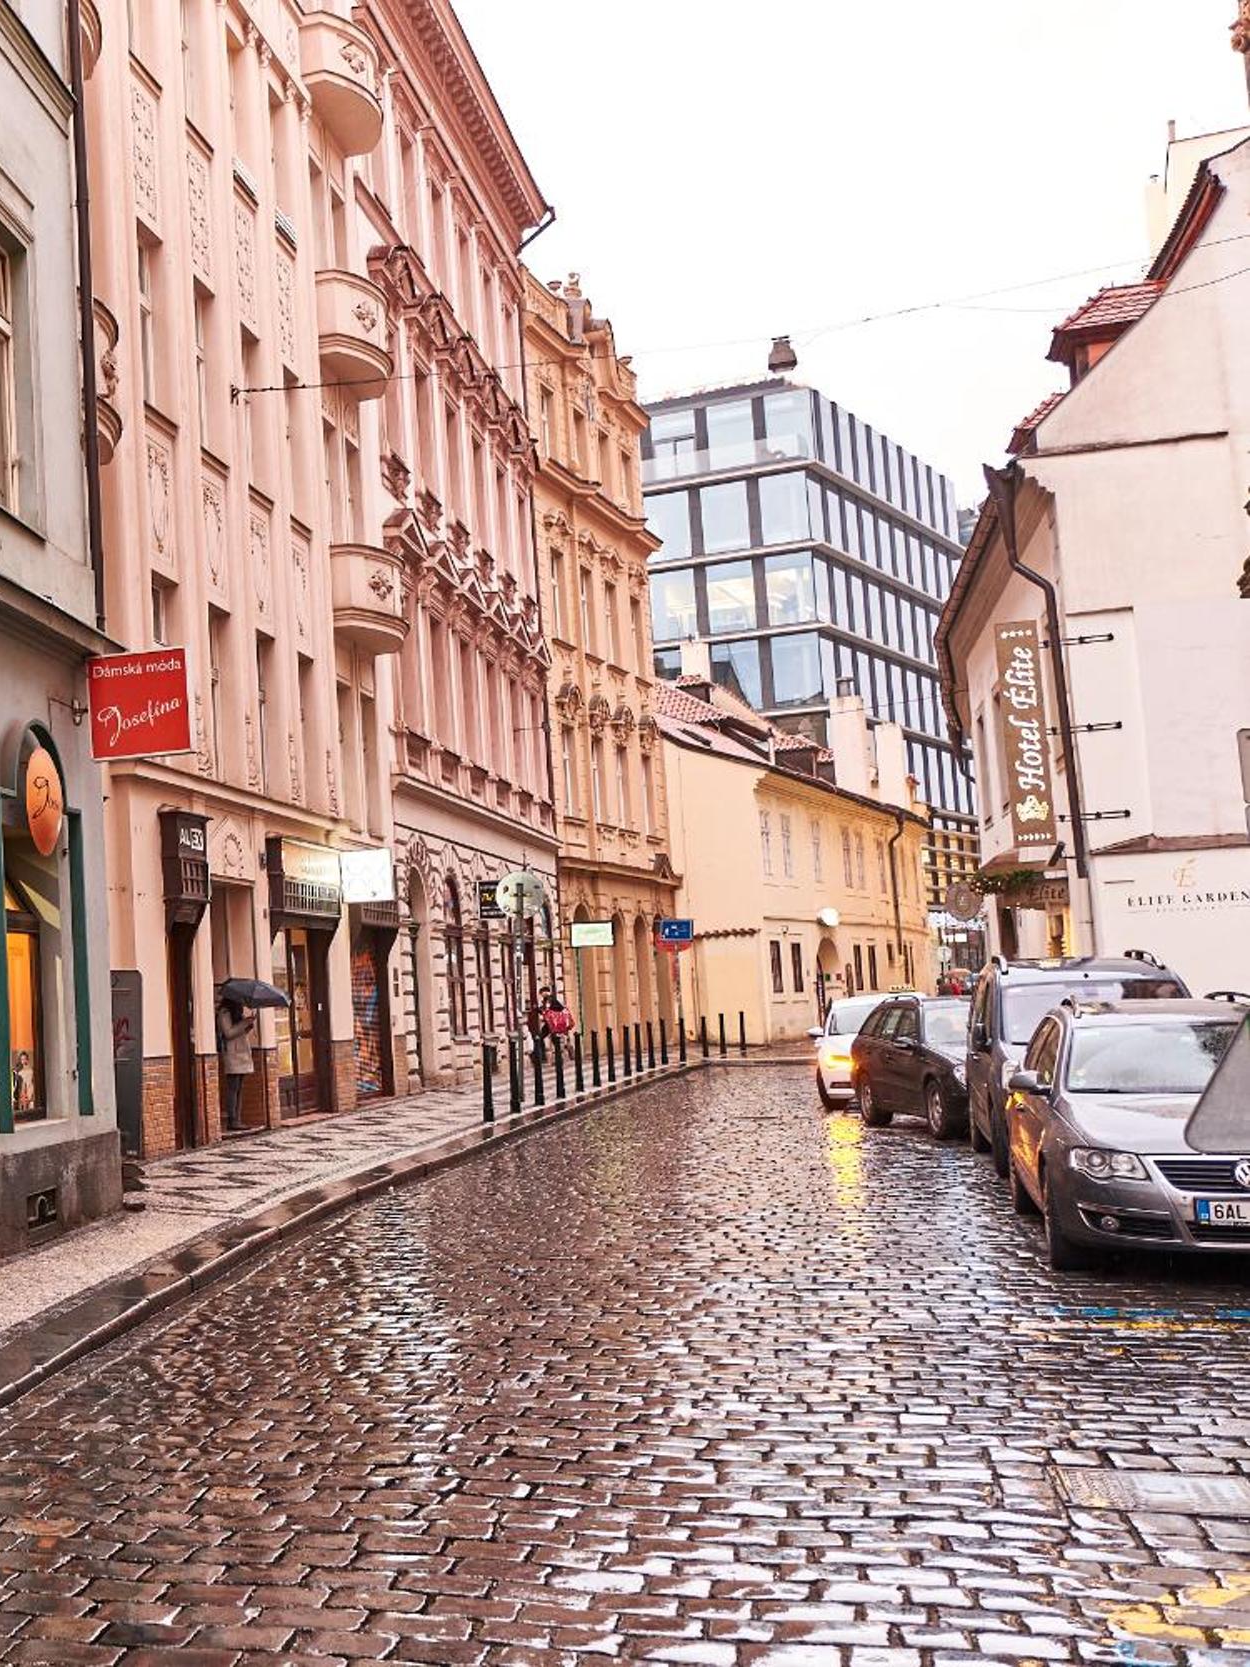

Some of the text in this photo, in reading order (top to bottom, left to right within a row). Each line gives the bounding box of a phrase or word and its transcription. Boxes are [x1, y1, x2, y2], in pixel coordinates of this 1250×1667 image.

[92, 657, 182, 679] Dámská móda
[97, 697, 183, 748] Josefina
[1008, 714, 1046, 792] Hotel
[1214, 1204, 1248, 1220] 6AL
